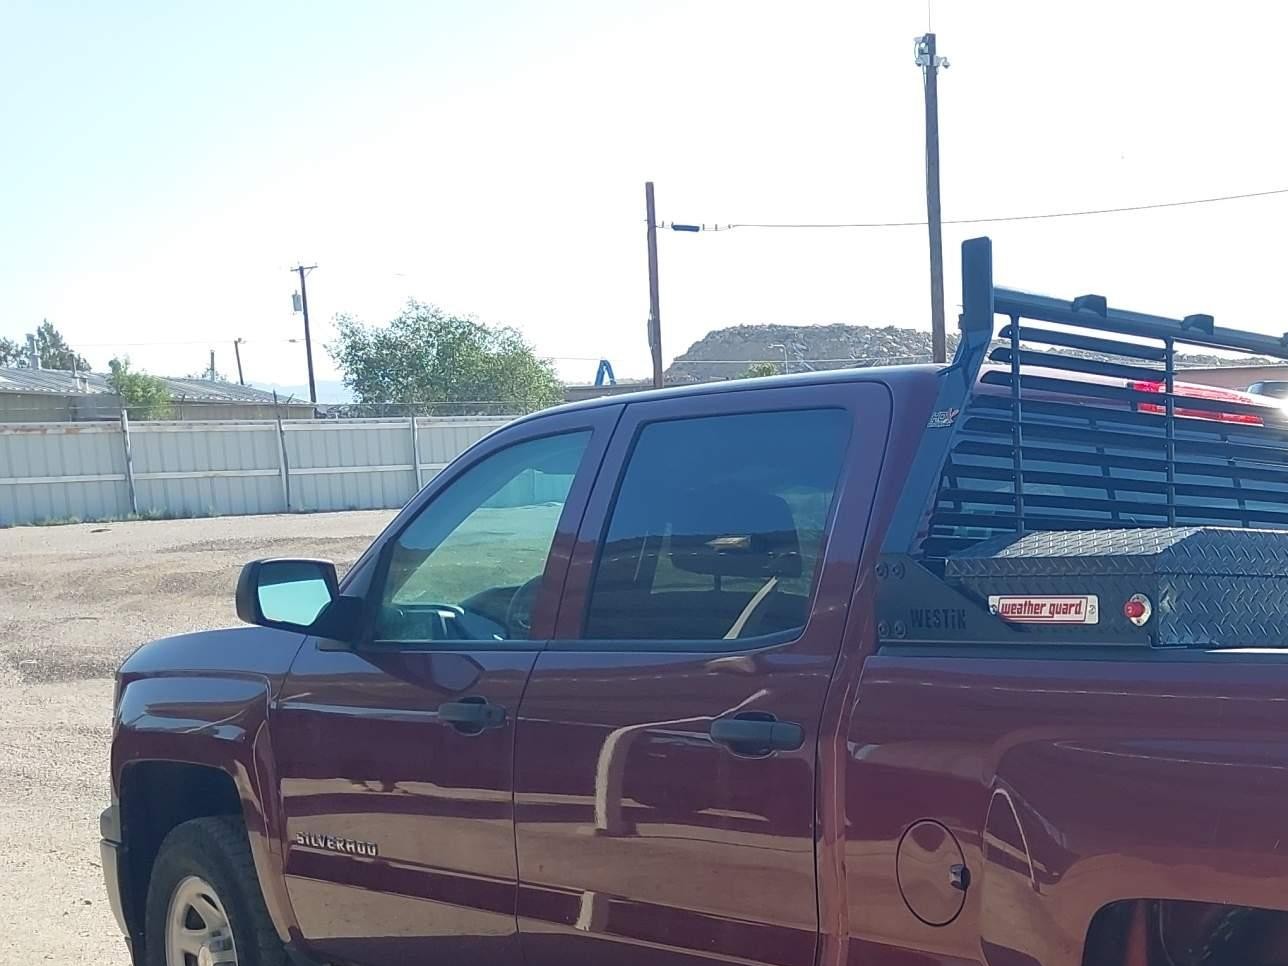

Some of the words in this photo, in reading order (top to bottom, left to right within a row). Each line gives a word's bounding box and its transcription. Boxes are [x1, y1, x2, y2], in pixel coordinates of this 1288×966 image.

[1001, 600, 1046, 615] weather
[1049, 600, 1082, 617] guard
[296, 832, 378, 856] SILVERADO
